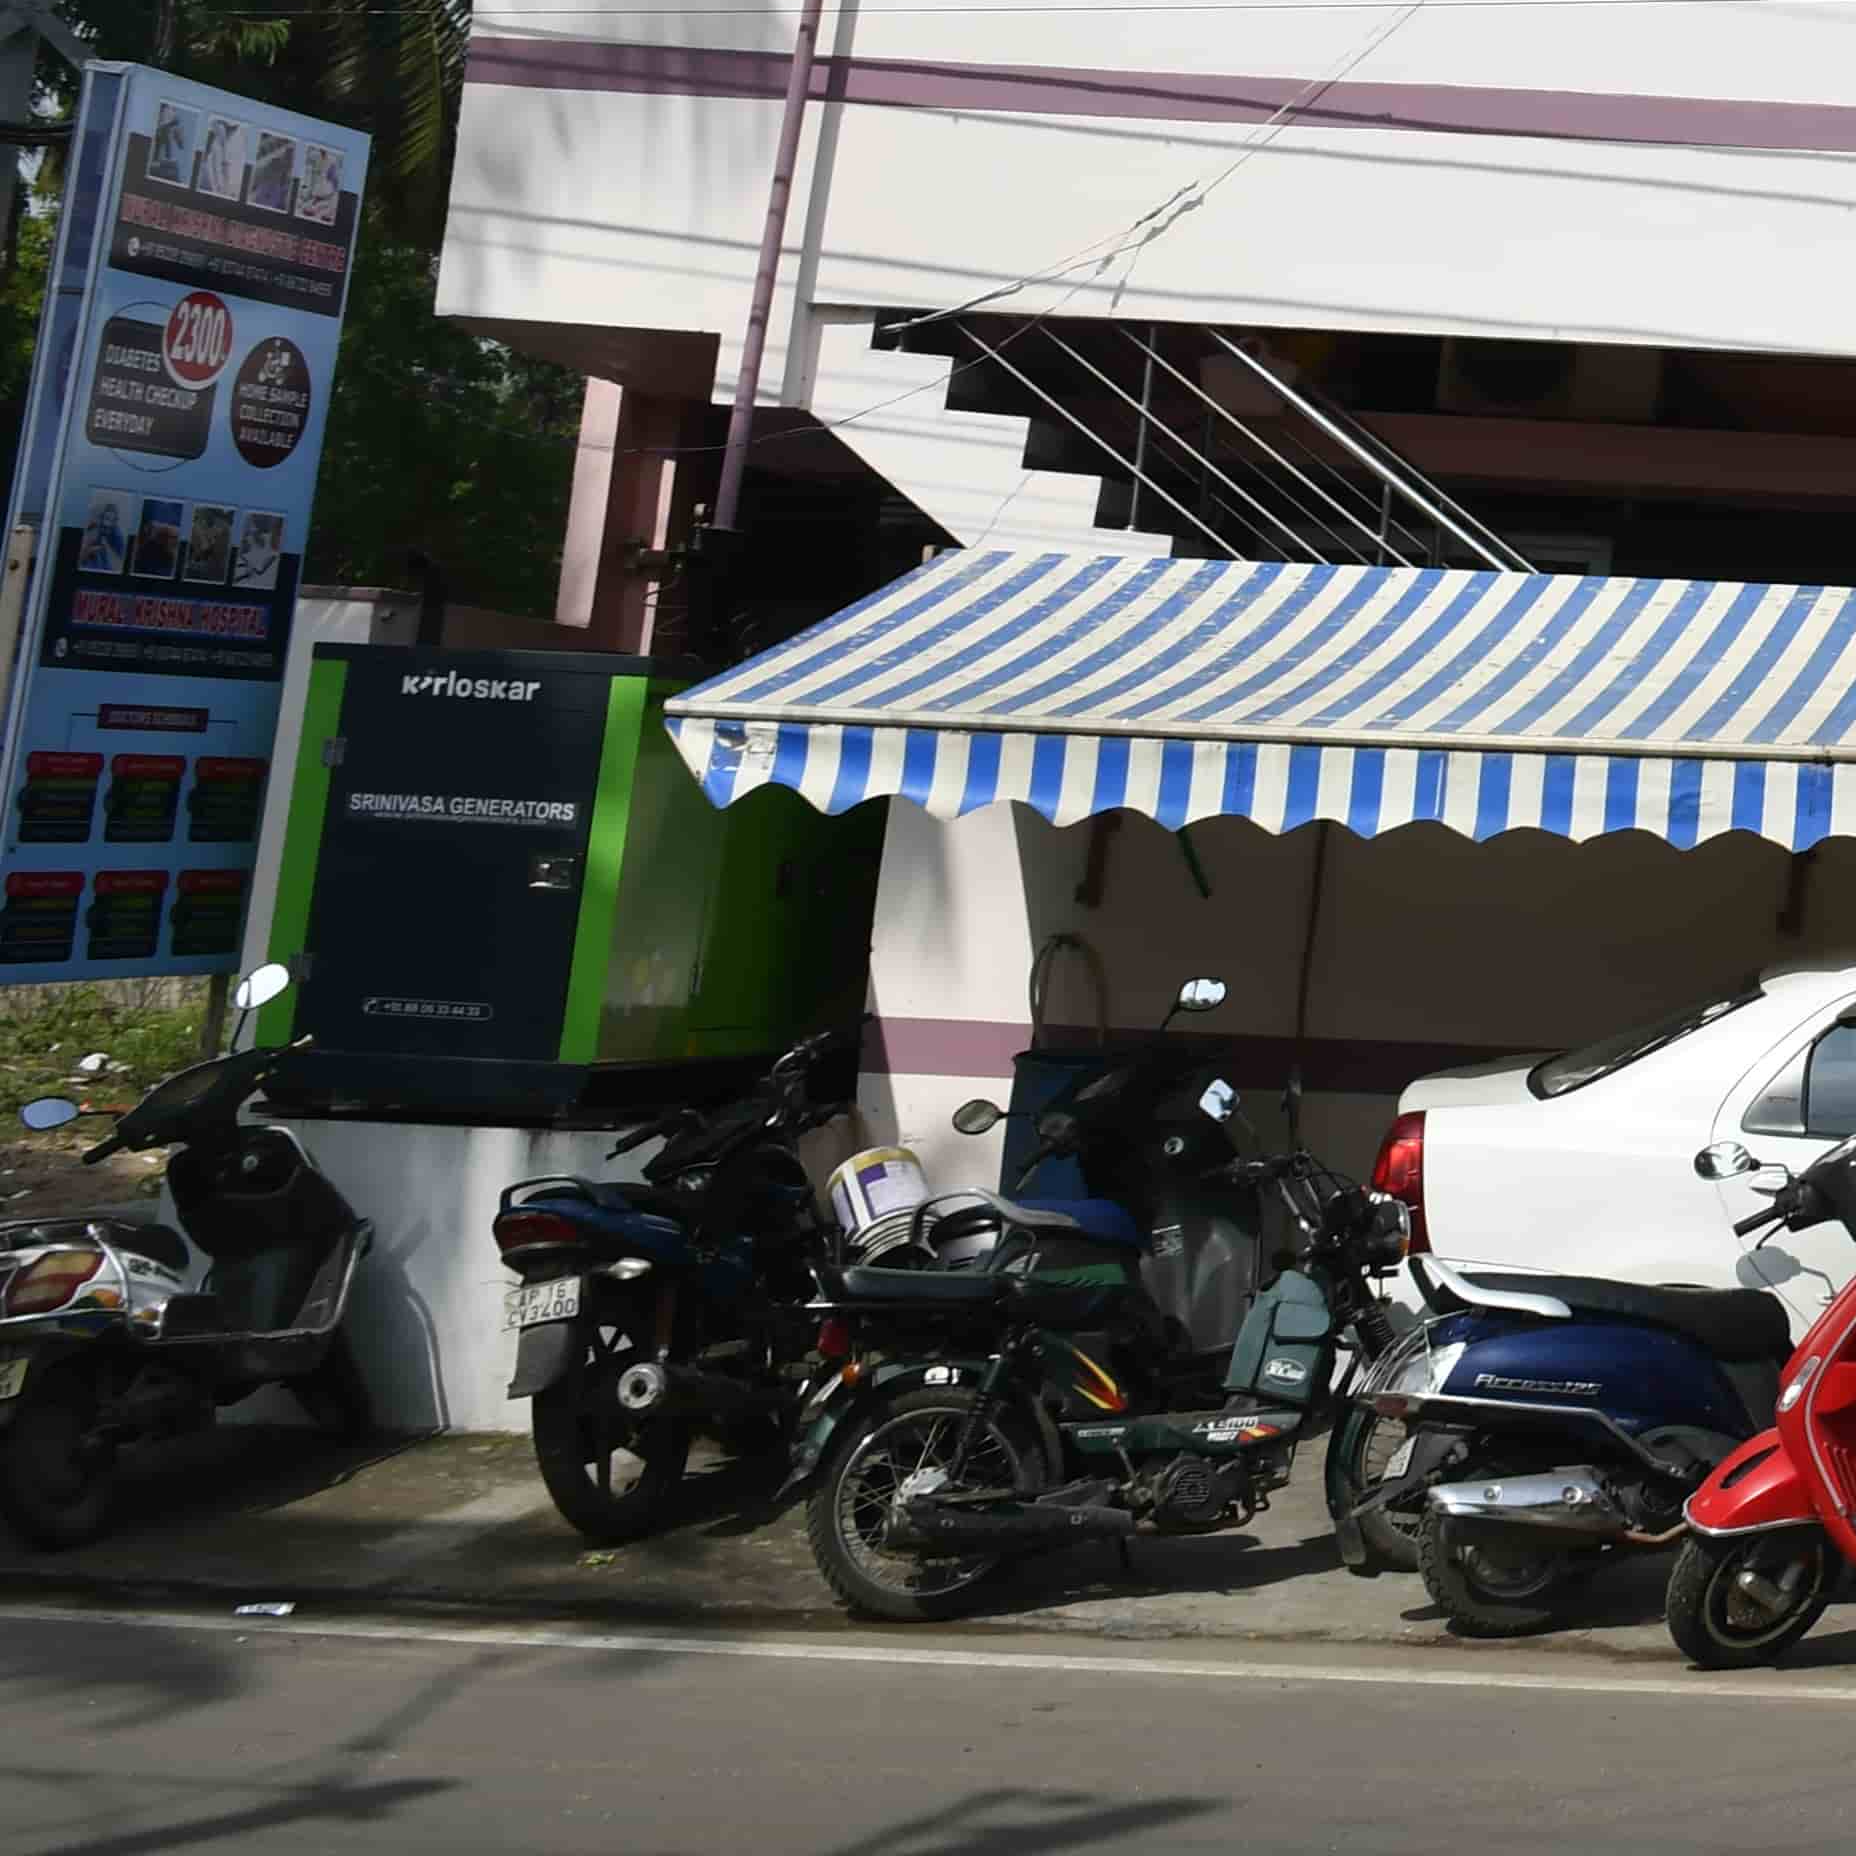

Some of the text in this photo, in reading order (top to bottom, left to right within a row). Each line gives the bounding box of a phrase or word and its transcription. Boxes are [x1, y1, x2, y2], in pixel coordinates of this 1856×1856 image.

[103, 343, 162, 374] DIABETES
[93, 407, 154, 437] EVERYDAY
[350, 793, 446, 814] SRINIVASA
[449, 797, 575, 821] GENERATORS
